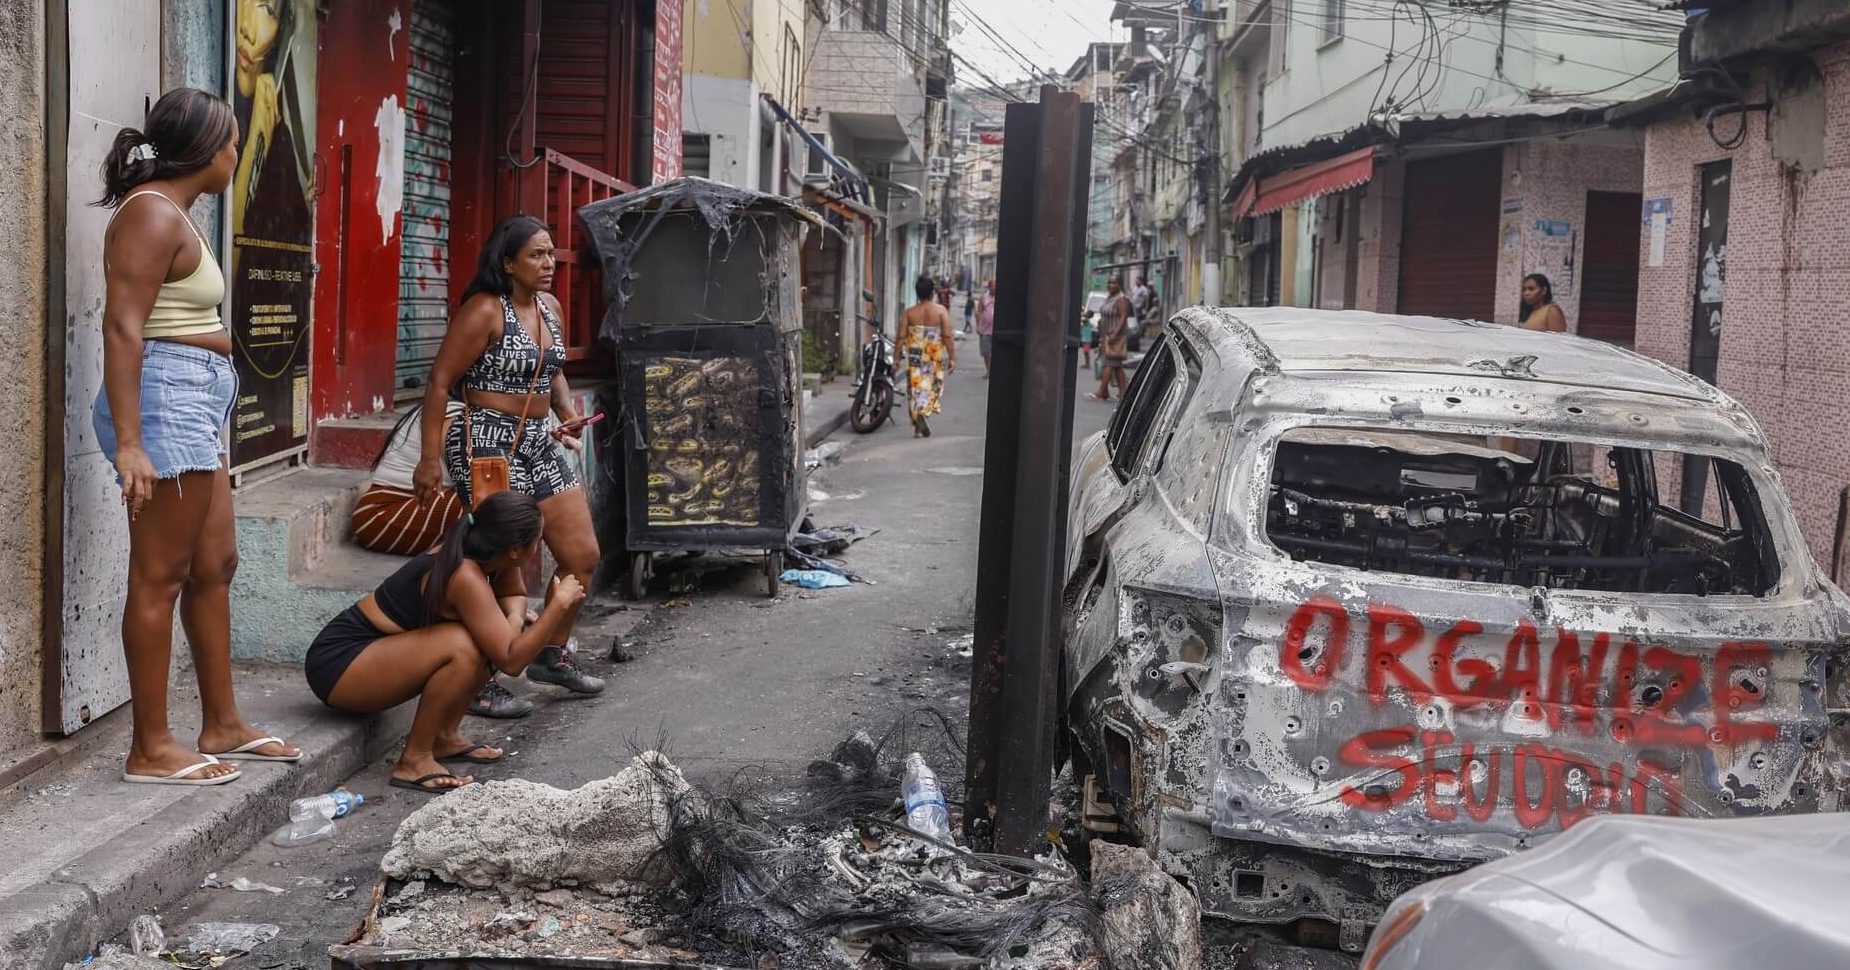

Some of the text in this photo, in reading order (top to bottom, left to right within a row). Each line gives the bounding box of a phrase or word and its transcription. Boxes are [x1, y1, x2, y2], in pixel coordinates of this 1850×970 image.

[503, 335, 522, 350] ES
[484, 354, 536, 372] LIVES
[500, 349, 527, 359] LIVES
[479, 424, 516, 443] LIVES
[470, 439, 498, 448] LIVES
[546, 460, 565, 488] LIVES
[1281, 594, 1782, 746] ORGANIZE
[1339, 724, 1498, 822] SEU
